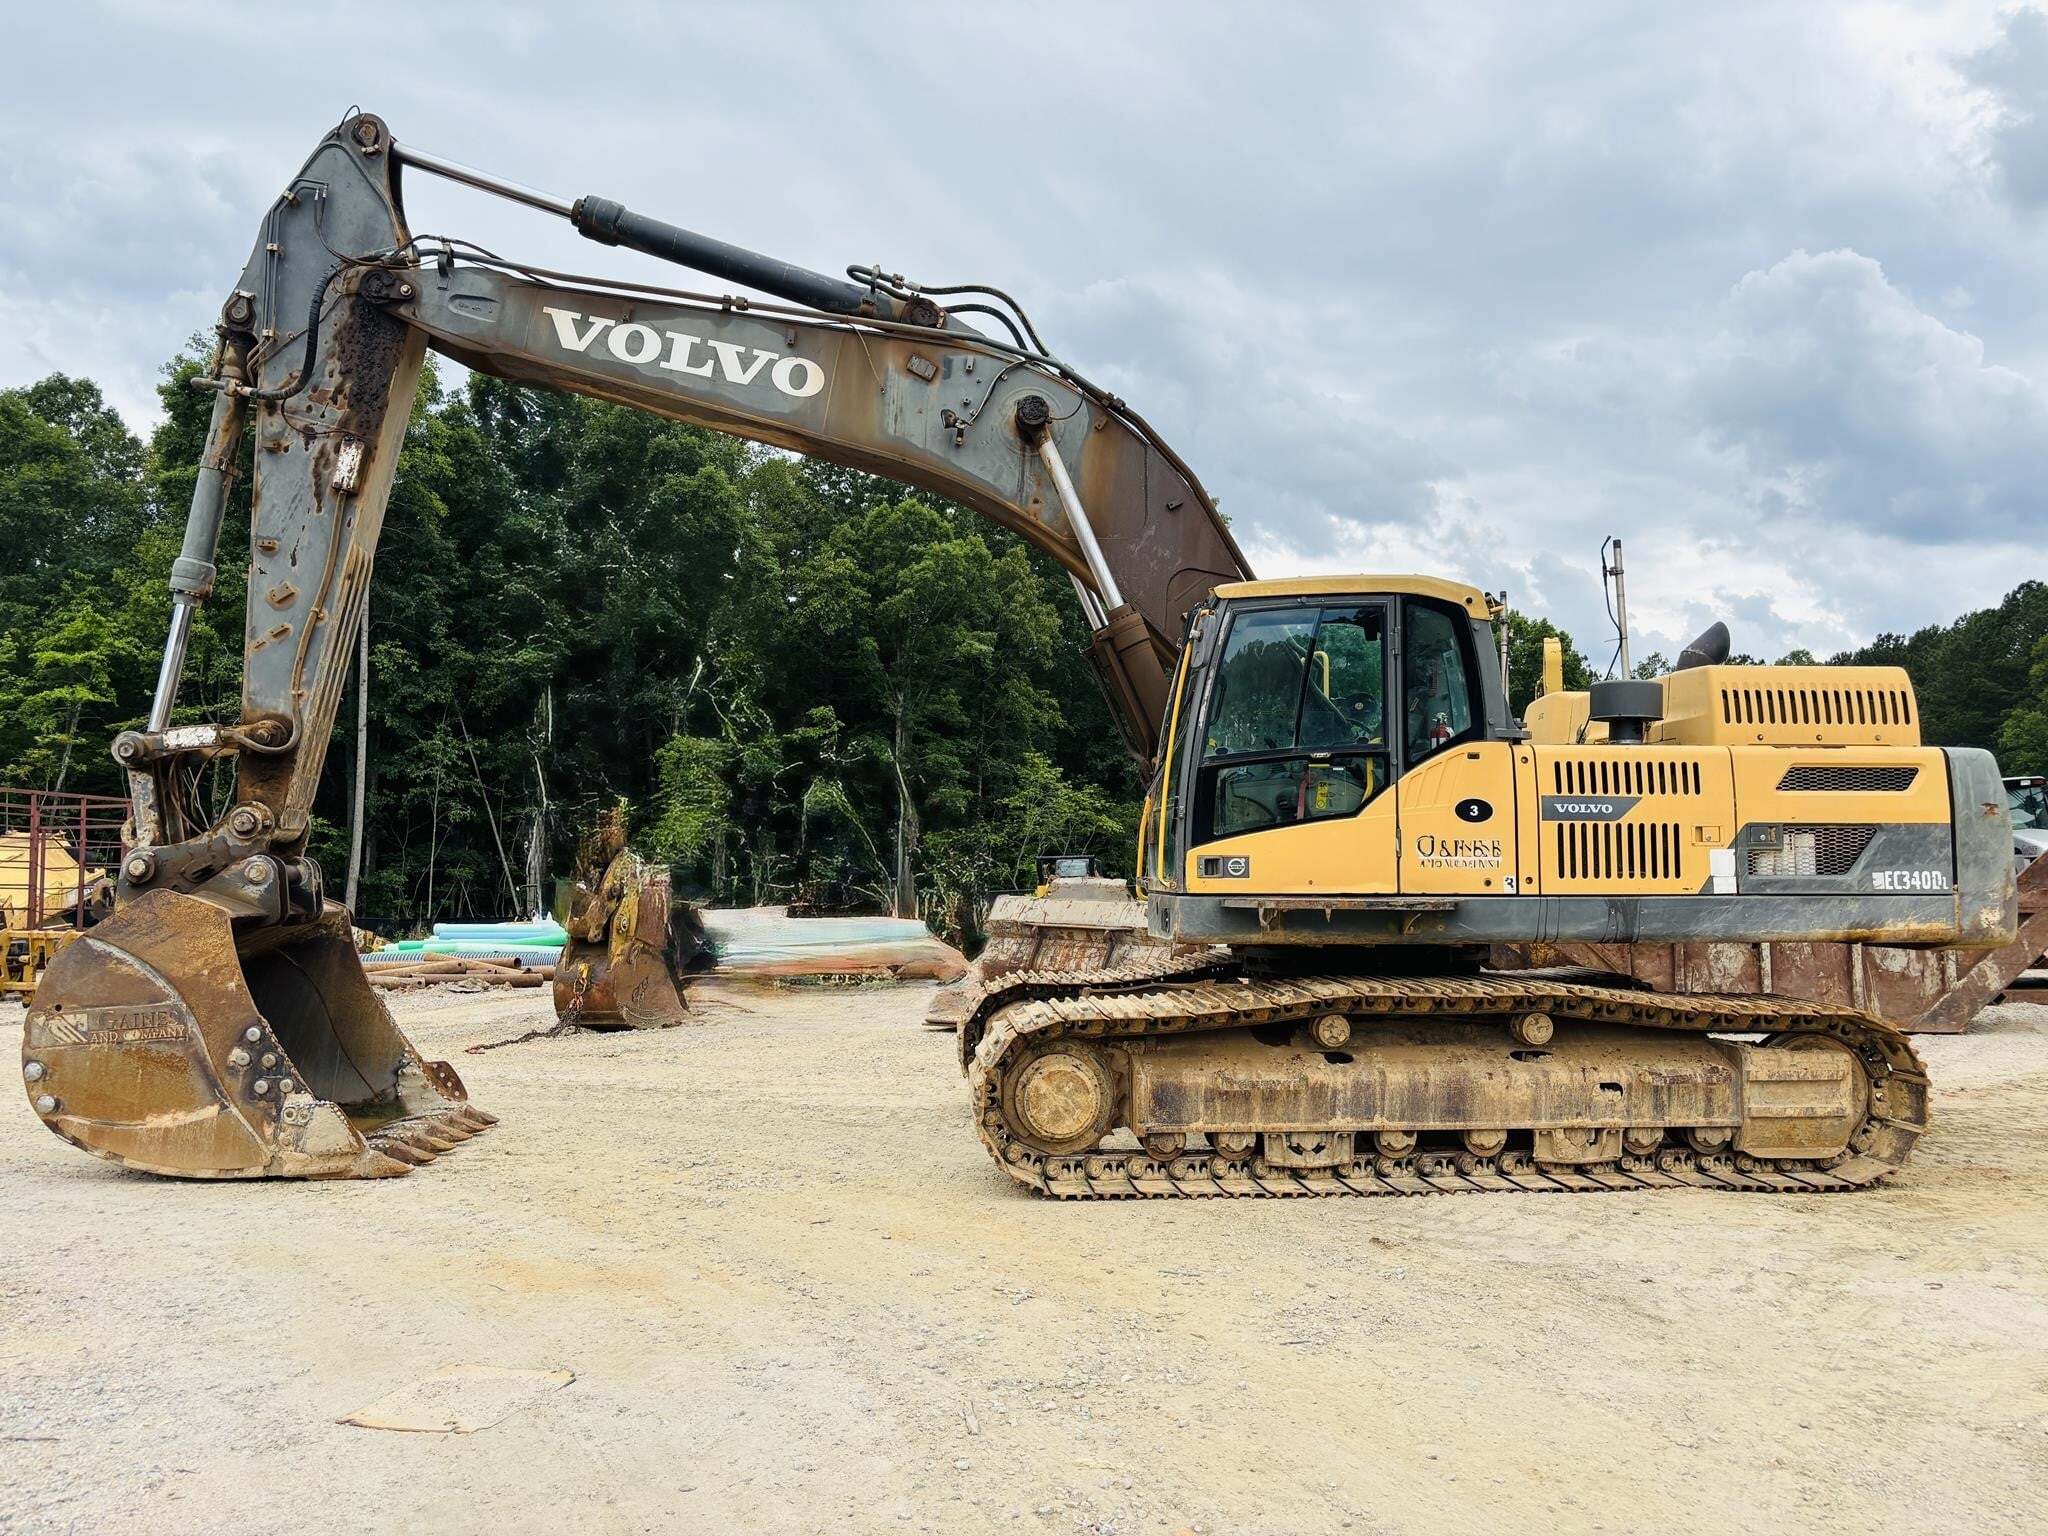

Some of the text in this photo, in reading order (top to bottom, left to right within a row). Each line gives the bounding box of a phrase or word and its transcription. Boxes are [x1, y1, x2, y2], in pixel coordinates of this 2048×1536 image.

[543, 307, 825, 397] VOLVO
[1469, 805, 1479, 817] 3
[1553, 803, 1614, 814] VOLVO
[91, 1032, 118, 1043] AND
